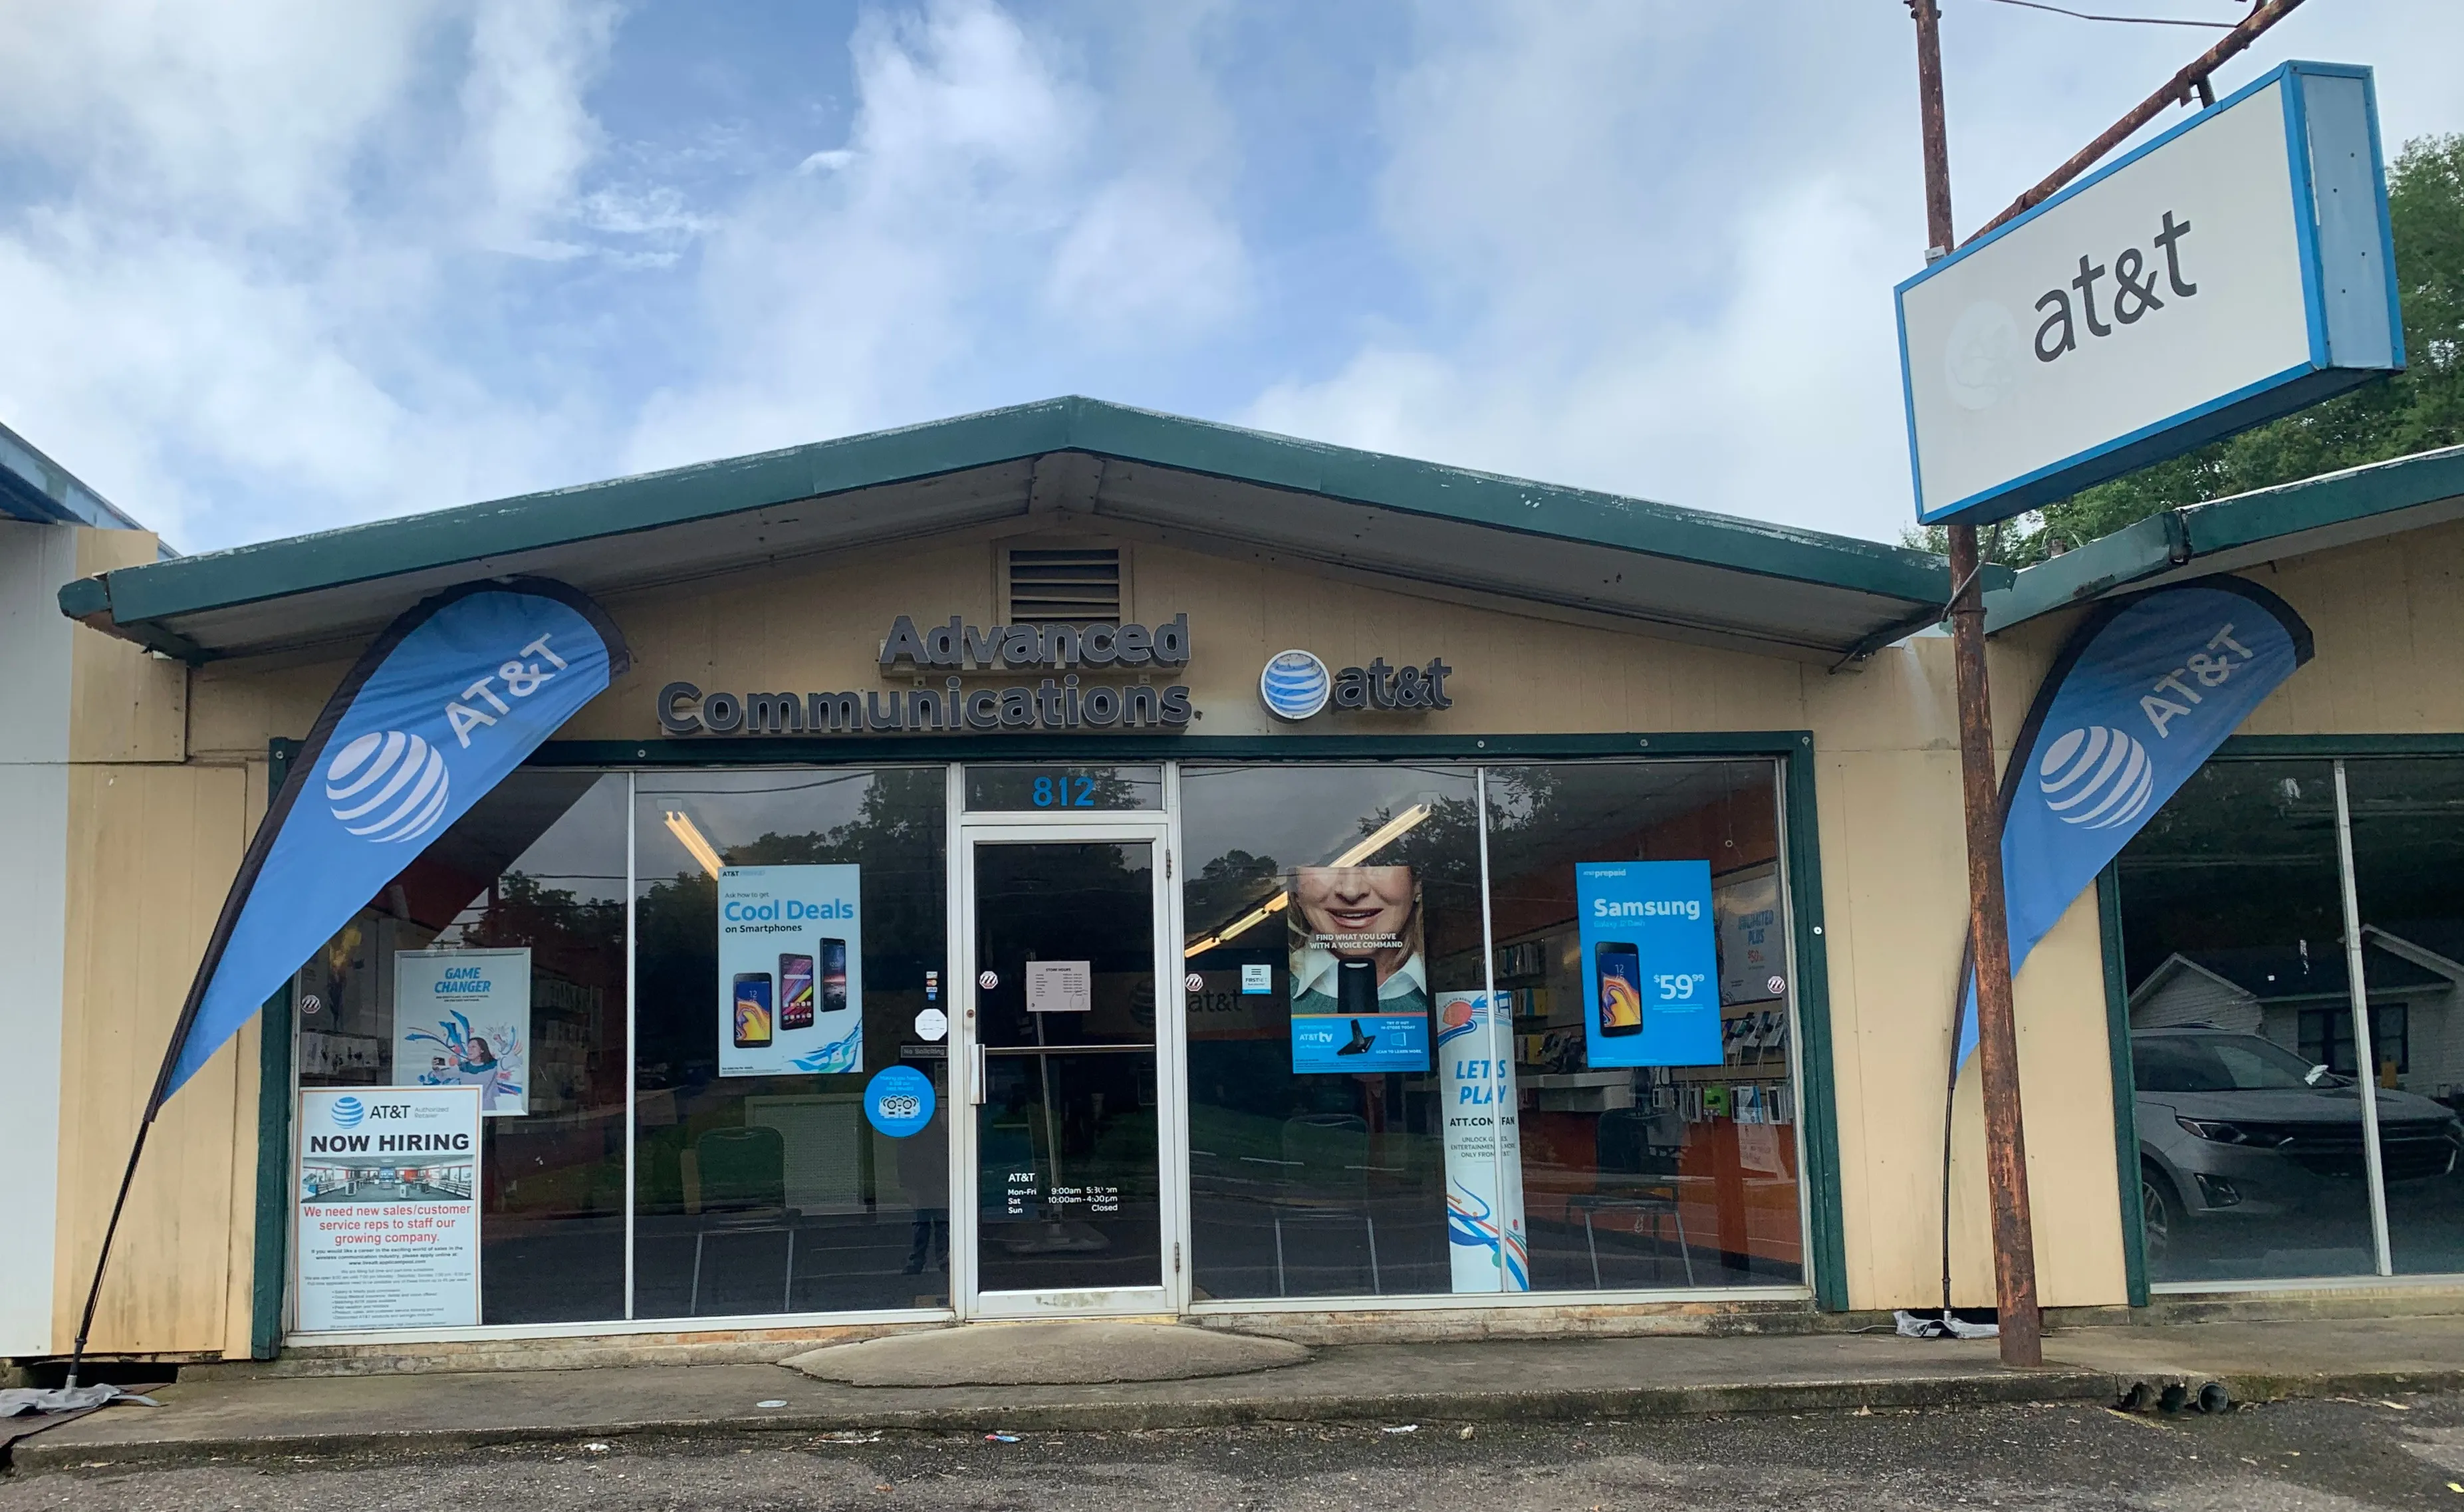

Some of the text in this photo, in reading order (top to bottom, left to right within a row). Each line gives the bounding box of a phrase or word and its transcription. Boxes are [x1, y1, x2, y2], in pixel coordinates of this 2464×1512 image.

[2034, 210, 2197, 362] at&t
[880, 613, 1191, 665] Advanced
[1332, 657, 1454, 709] at&t
[2140, 622, 2254, 739] AT&T
[444, 632, 568, 749] AT&T
[657, 674, 1193, 732] Communications
[1033, 777, 1094, 807] 812
[1595, 868, 1626, 878] prepaid
[725, 898, 854, 921] Cool Deals
[1594, 898, 1700, 920] Samsung
[739, 924, 802, 934] Smartphones
[1594, 920, 1617, 929] Galaxy
[445, 967, 481, 979] GAME
[434, 981, 491, 993] CHANGER
[1188, 989, 1243, 1013] at&t
[1456, 1059, 1506, 1079] LETS
[370, 1105, 411, 1119] AT&T
[310, 1134, 469, 1153] NOW HIRING
[1008, 1173, 1035, 1182] AT&T
[304, 1206, 322, 1216] We
[325, 1205, 353, 1216] need
[383, 1204, 471, 1215] sales/customer
[319, 1217, 455, 1231] service reps to staff our
[335, 1232, 439, 1246] growing company.
